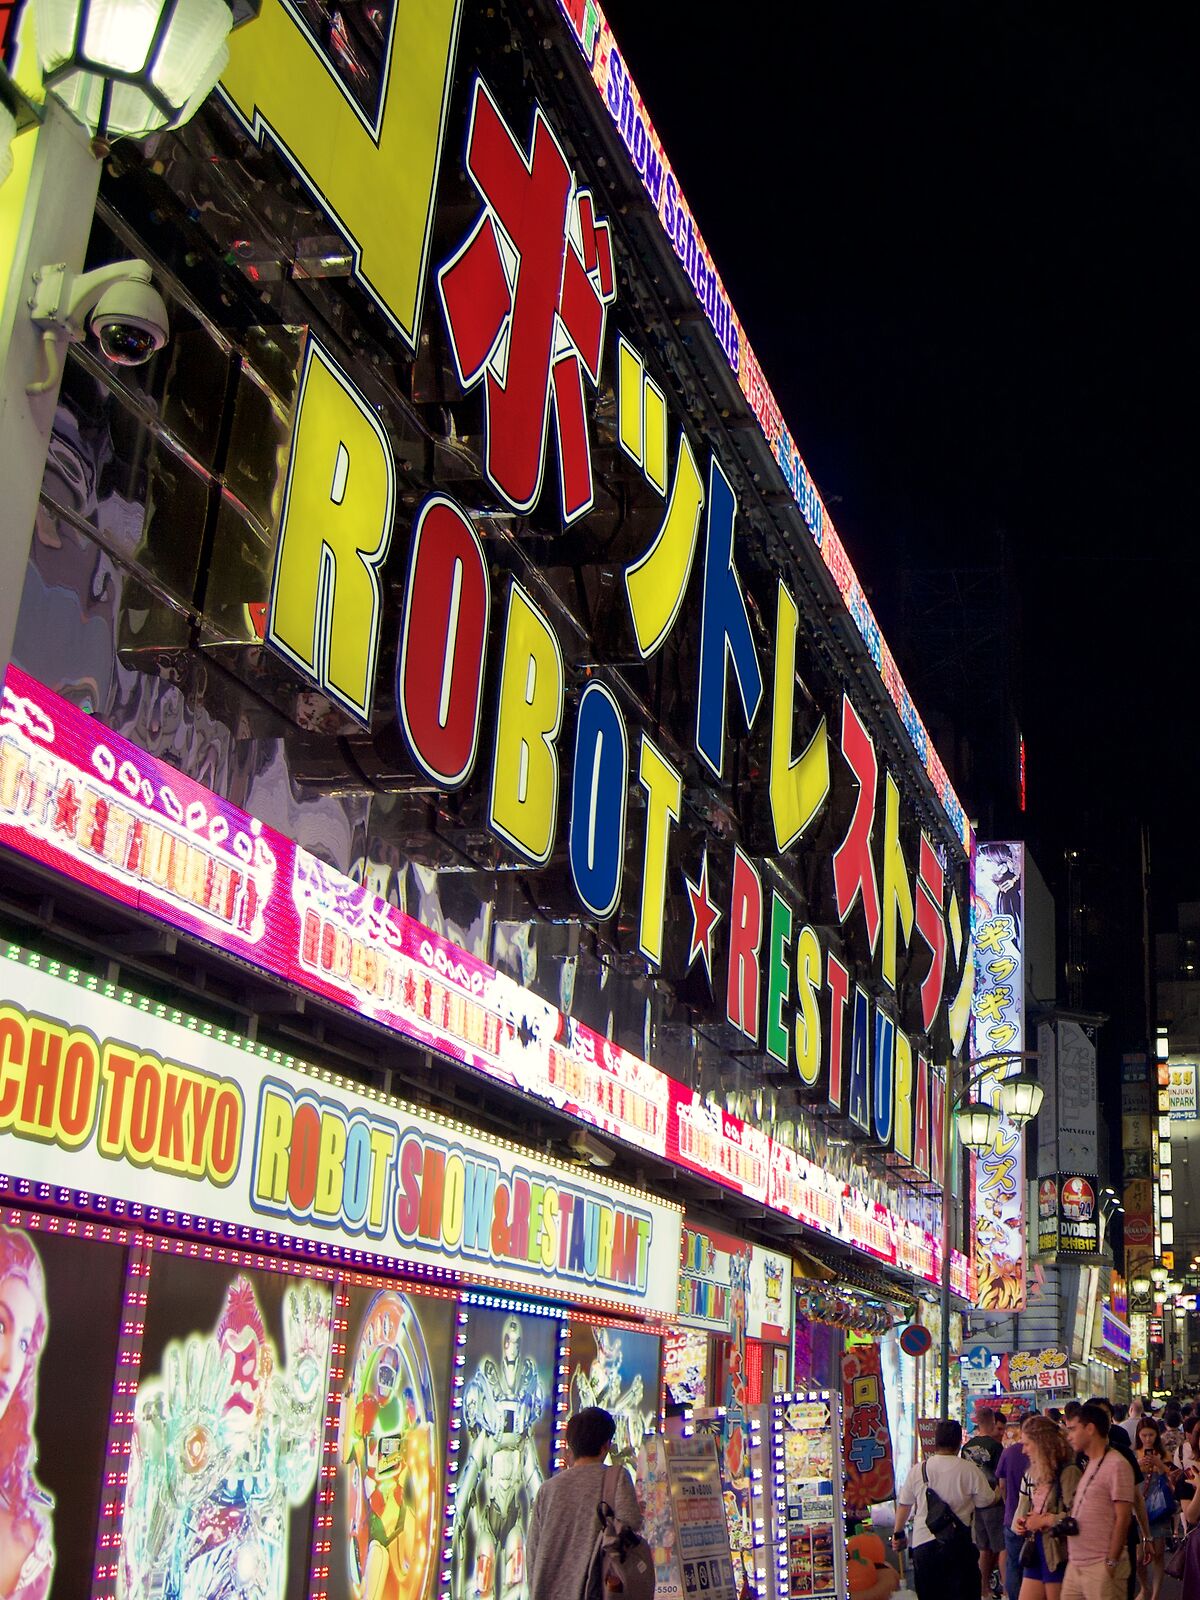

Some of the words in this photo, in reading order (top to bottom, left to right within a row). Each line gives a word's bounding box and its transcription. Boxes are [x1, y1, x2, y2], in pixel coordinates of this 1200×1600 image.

[606, 47, 663, 211] Show
[660, 172, 741, 373] Schedule
[265, 330, 683, 970] ROBOT
[106, 1048, 240, 1178] TOKYO
[255, 1088, 397, 1230] ROBOT
[1169, 1097, 1195, 1107] NPARK
[1038, 1369, 1067, 1388] 受付
